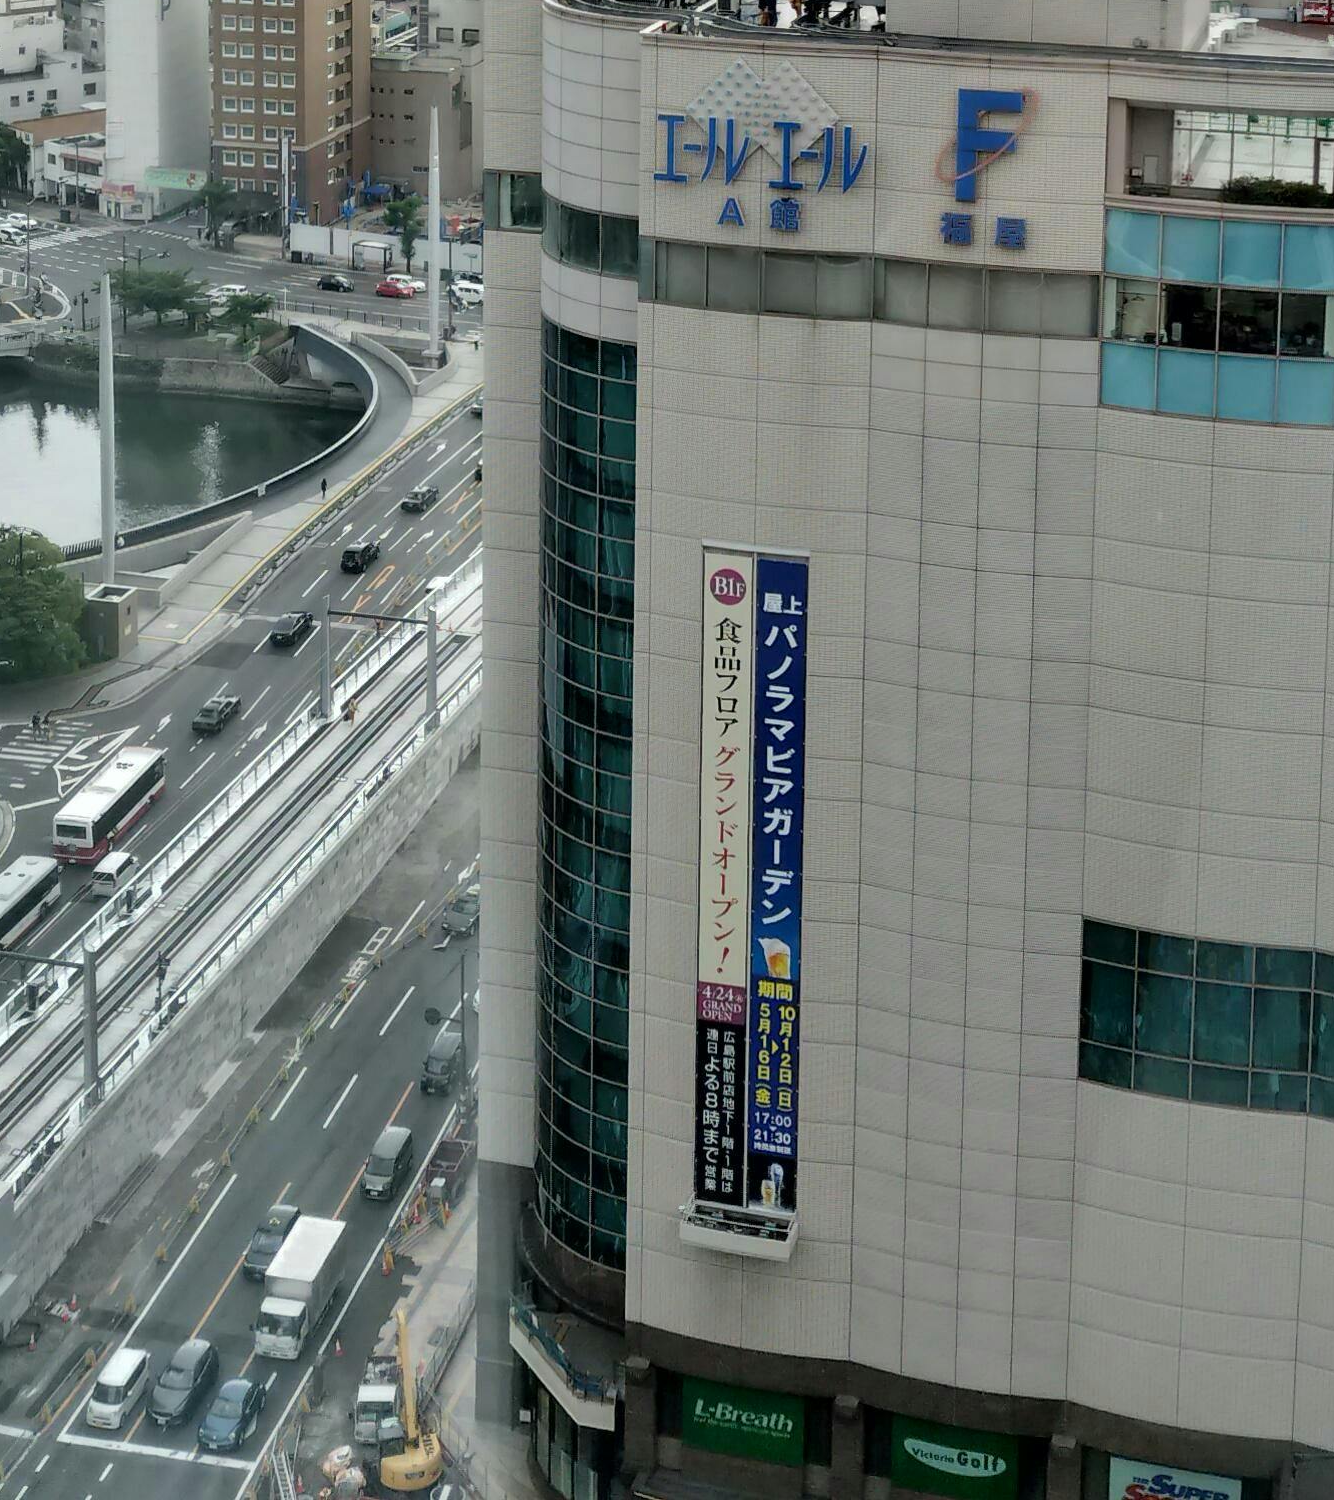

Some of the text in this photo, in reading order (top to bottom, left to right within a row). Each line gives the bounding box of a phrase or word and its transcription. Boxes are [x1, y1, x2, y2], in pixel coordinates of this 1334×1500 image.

[653, 113, 868, 194] エールエール
[939, 211, 1027, 250] 福屋
[762, 592, 804, 616] 屋上
[761, 624, 799, 925] パノラマビアガーデン
[757, 979, 794, 1002] 期間
[702, 999, 742, 1014] GRAND
[702, 1009, 733, 1021] OPEN
[754, 1111, 792, 1128] 17:00
[694, 1398, 794, 1433] L-Breath
[911, 1447, 999, 1472] Victoria Golf
[1148, 1474, 1230, 1500] SUPER
